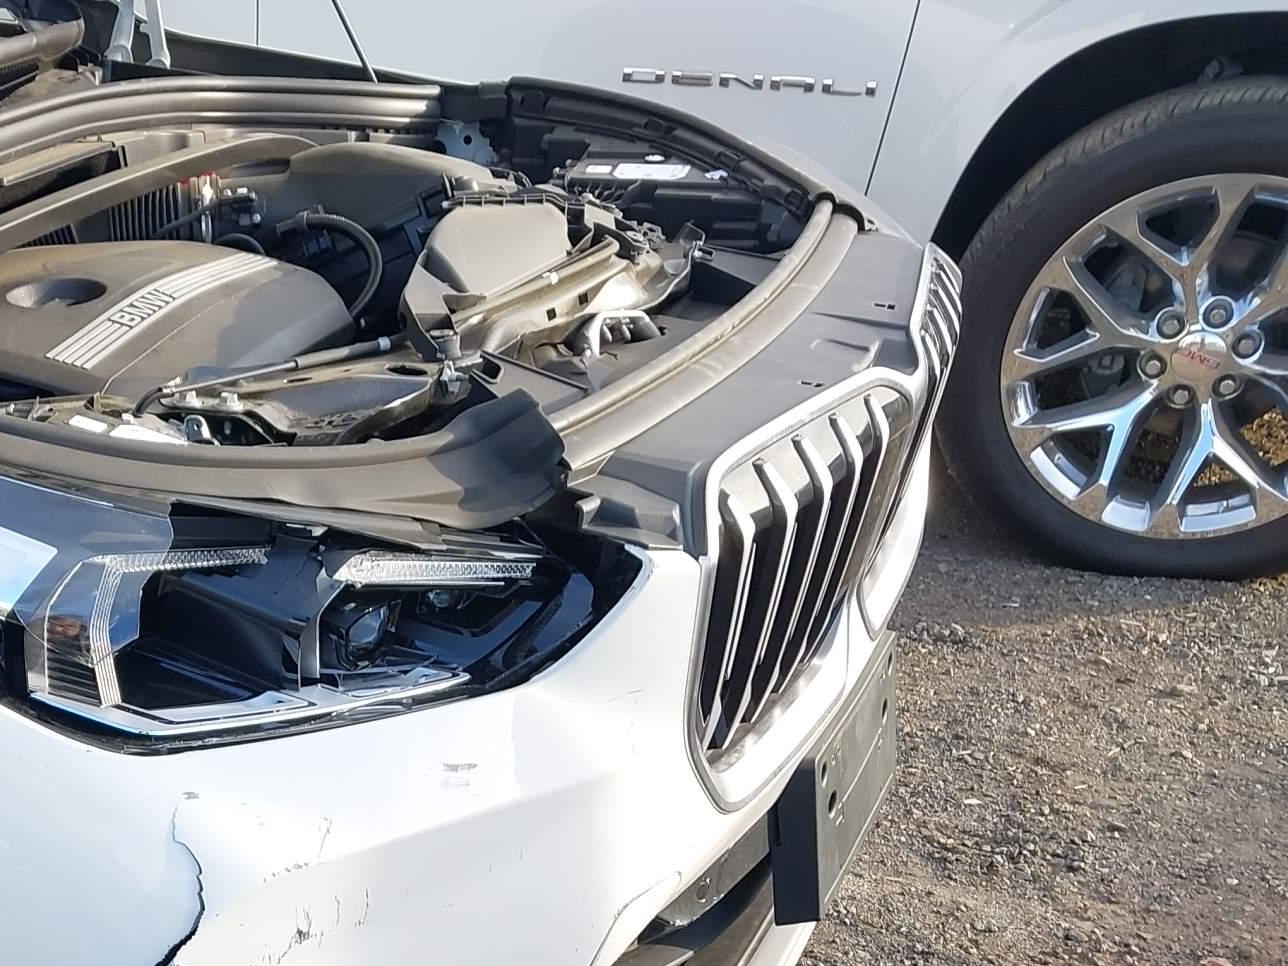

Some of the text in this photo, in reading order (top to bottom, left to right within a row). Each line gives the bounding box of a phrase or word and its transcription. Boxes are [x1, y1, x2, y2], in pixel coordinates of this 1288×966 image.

[622, 66, 878, 97] DENALI
[117, 287, 176, 328] BMW
[1176, 346, 1221, 370] GMC
